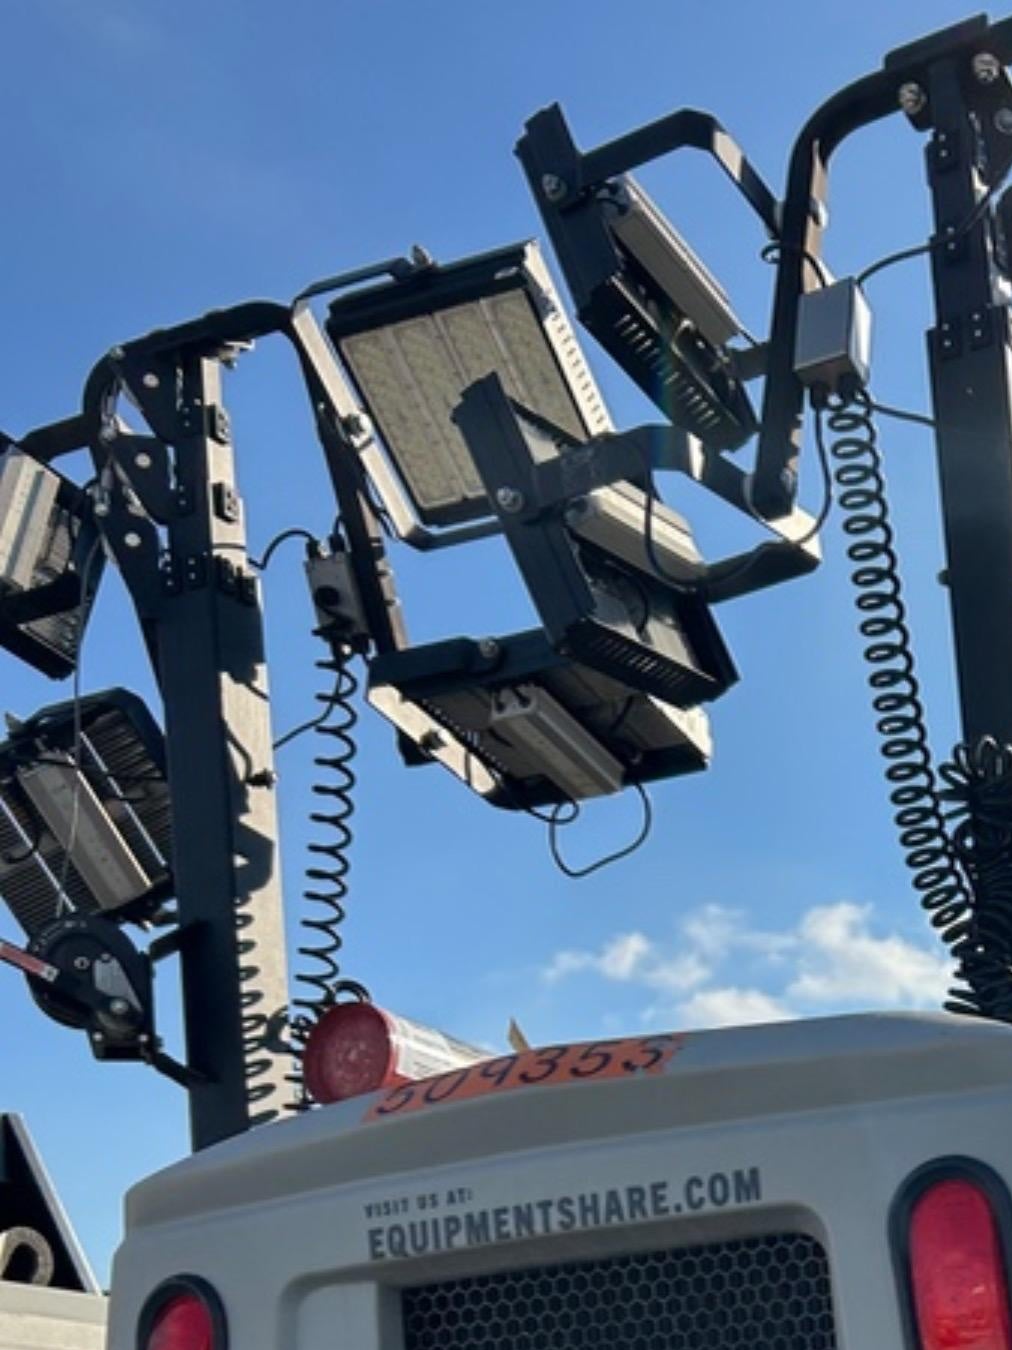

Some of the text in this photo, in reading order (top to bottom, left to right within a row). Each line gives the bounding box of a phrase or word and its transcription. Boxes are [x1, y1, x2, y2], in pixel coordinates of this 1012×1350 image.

[364, 1198, 408, 1218] VISIT
[416, 1194, 439, 1210] US
[367, 1166, 761, 1261] EQUIPMENTSHARE.COM
